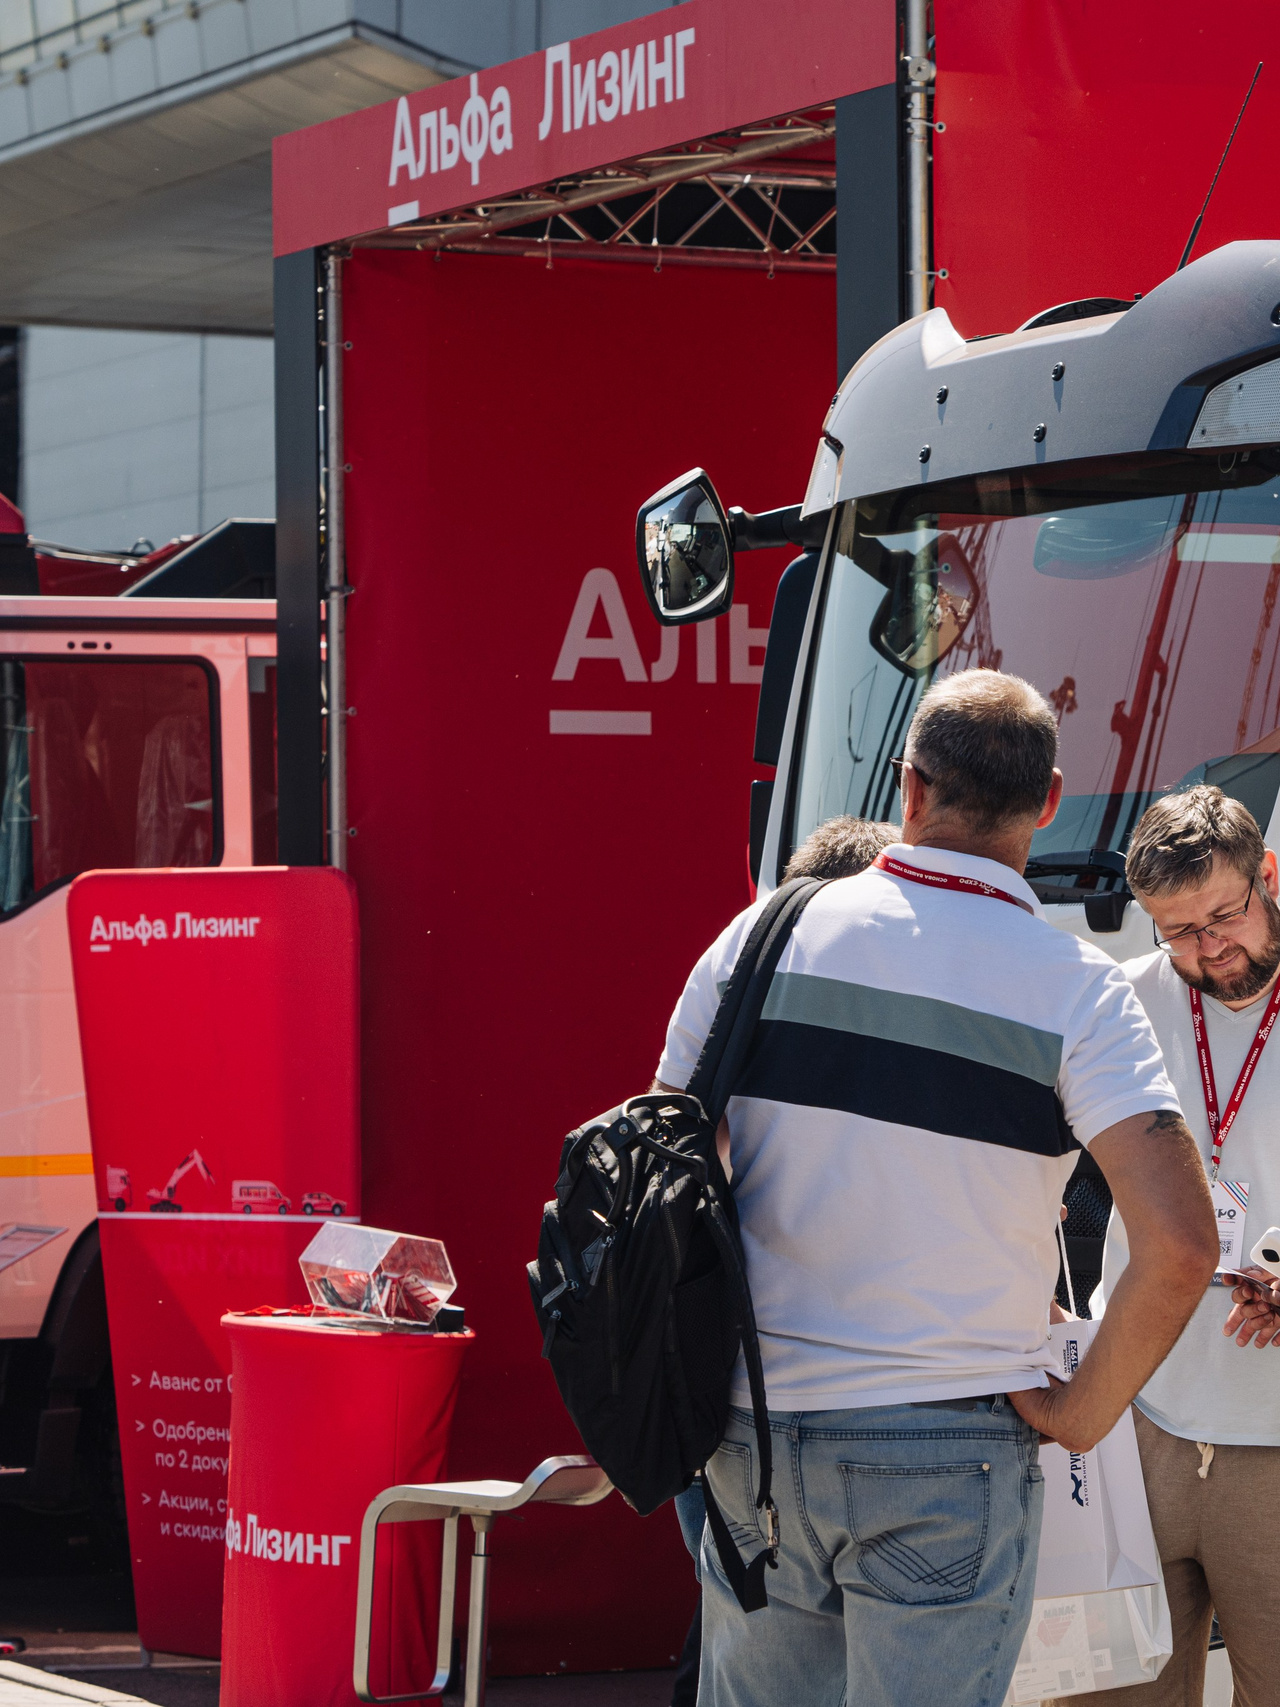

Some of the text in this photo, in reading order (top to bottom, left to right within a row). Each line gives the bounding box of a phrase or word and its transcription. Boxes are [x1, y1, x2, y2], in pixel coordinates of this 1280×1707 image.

[388, 27, 695, 187] Альфа Лизинг
[551, 567, 771, 684] Аль
[90, 912, 260, 946] Альфа Лизинг
[1235, 1083, 1244, 1102] ОСНОВА
[149, 1370, 201, 1392] Аванс
[204, 1379, 223, 1393] от
[155, 1449, 229, 1476] по 2 доку
[158, 1489, 214, 1516] Акции,
[161, 1521, 170, 1535] и
[244, 1513, 351, 1566] Лизинг
